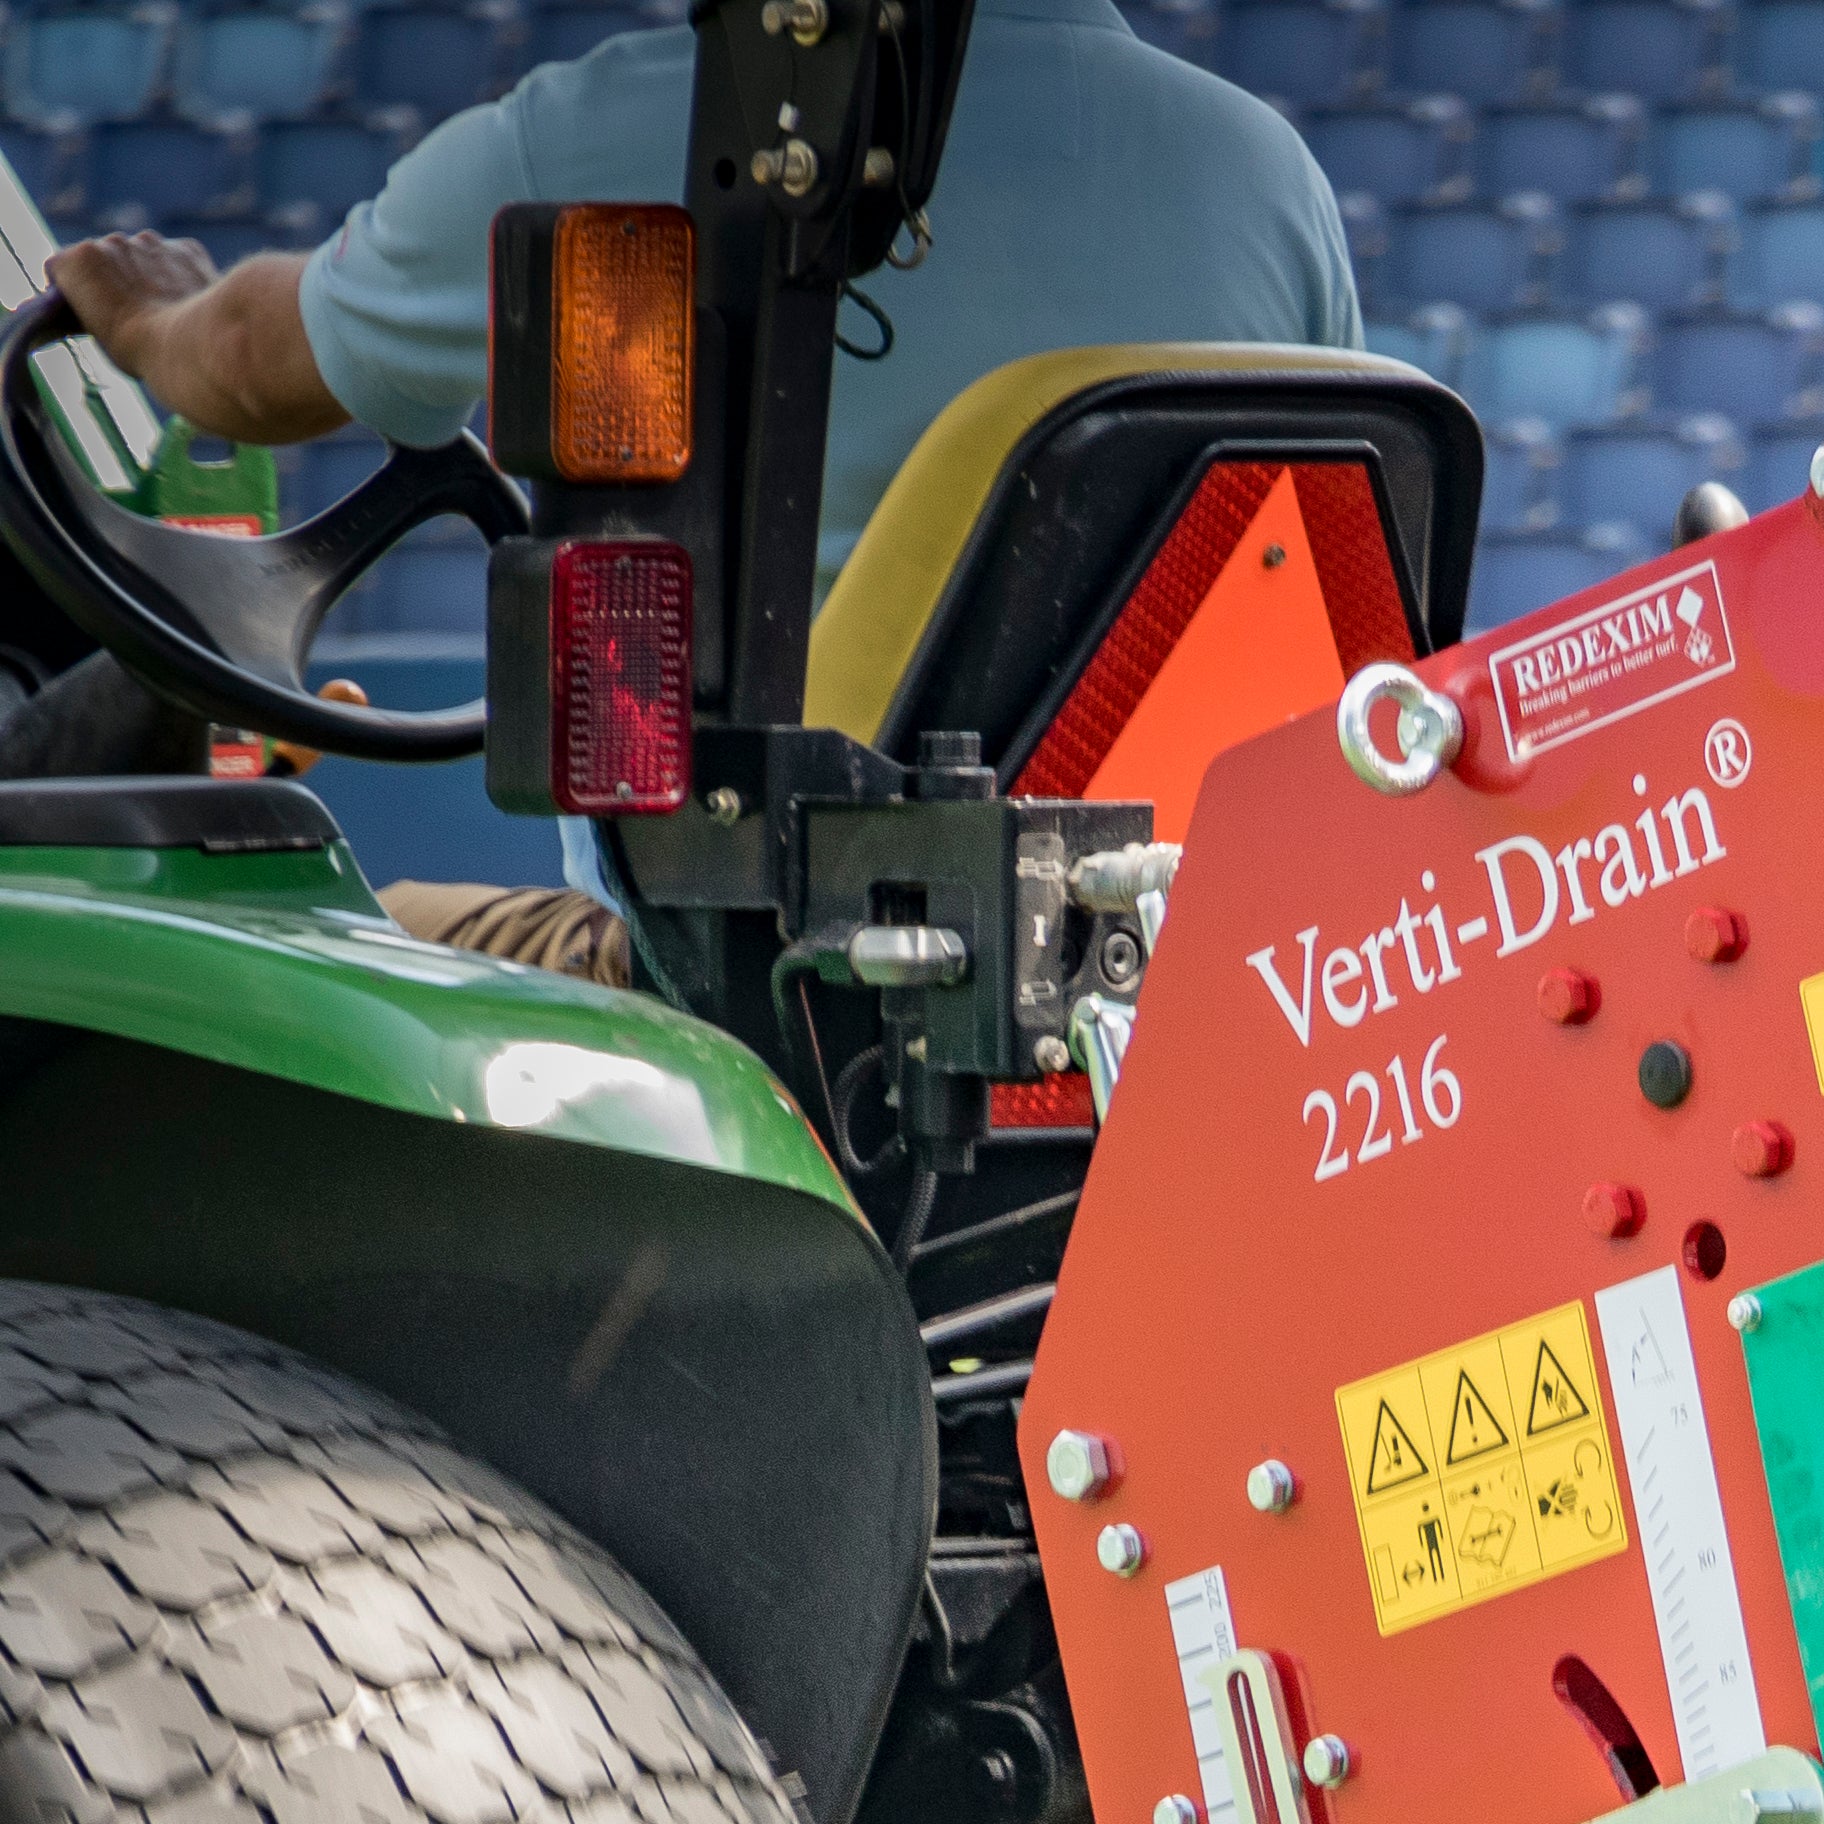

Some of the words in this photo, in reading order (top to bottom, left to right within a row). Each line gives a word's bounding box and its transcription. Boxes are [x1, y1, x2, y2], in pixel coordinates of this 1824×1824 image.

[1512, 594, 1673, 697] REDEXIM
[1519, 685, 1568, 719] Breaking
[1567, 668, 1610, 696] barriers
[1610, 660, 1623, 679] to
[1622, 646, 1654, 674] better
[1302, 1034, 1462, 1182] 2216
[1670, 1402, 1689, 1428] 75
[1697, 1547, 1716, 1572] 80
[1203, 1570, 1222, 1613] 225
[1719, 1659, 1737, 1686] 85
